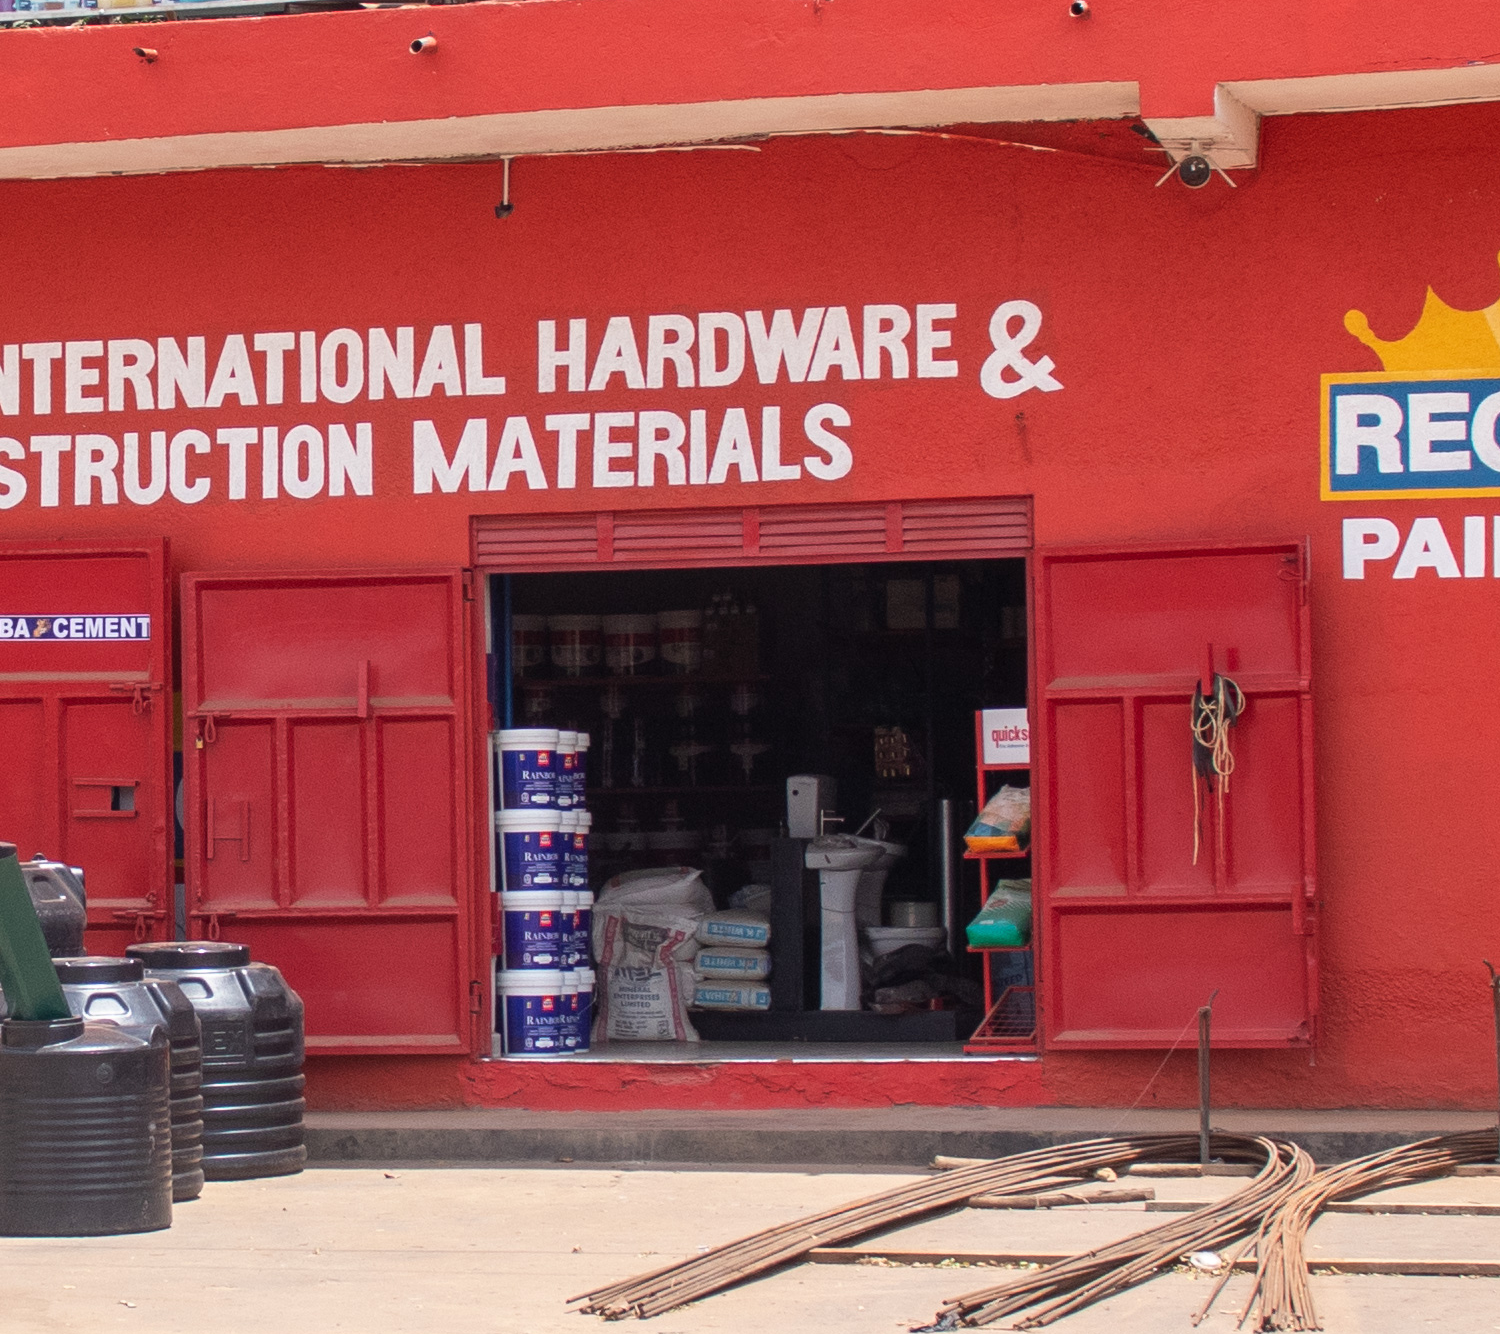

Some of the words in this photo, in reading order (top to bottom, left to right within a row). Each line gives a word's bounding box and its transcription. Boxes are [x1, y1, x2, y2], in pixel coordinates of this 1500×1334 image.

[538, 303, 958, 393] HARDWARE
[980, 299, 1064, 399] &
[413, 403, 853, 495] MATERIALS
[53, 617, 150, 638] CEMENT
